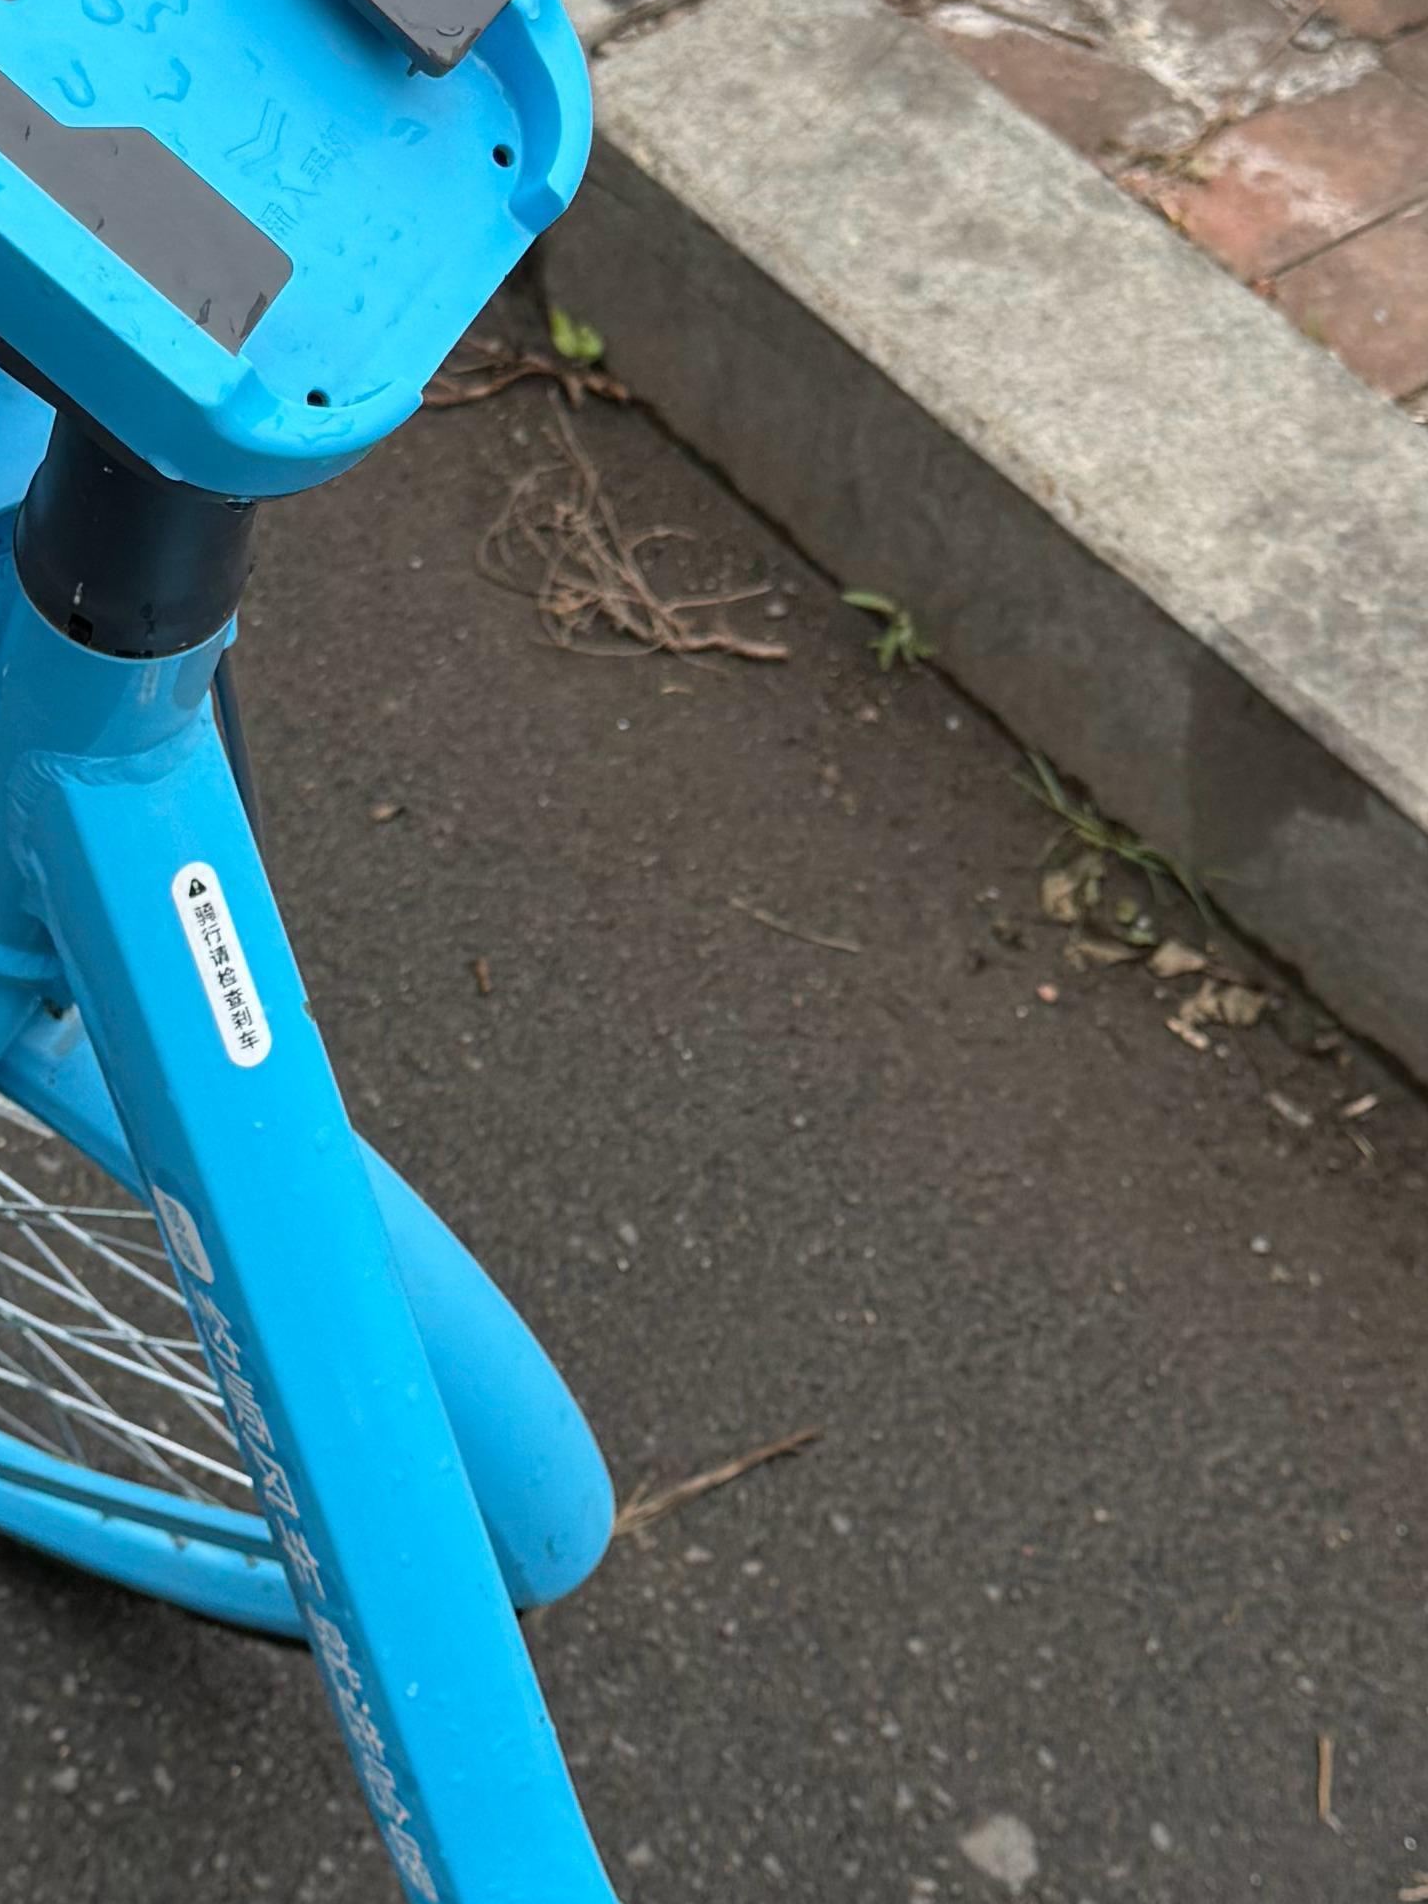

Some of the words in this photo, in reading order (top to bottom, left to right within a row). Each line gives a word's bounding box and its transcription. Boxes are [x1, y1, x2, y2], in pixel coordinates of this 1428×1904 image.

[194, 902, 261, 1050] 骑行请检查刹车
